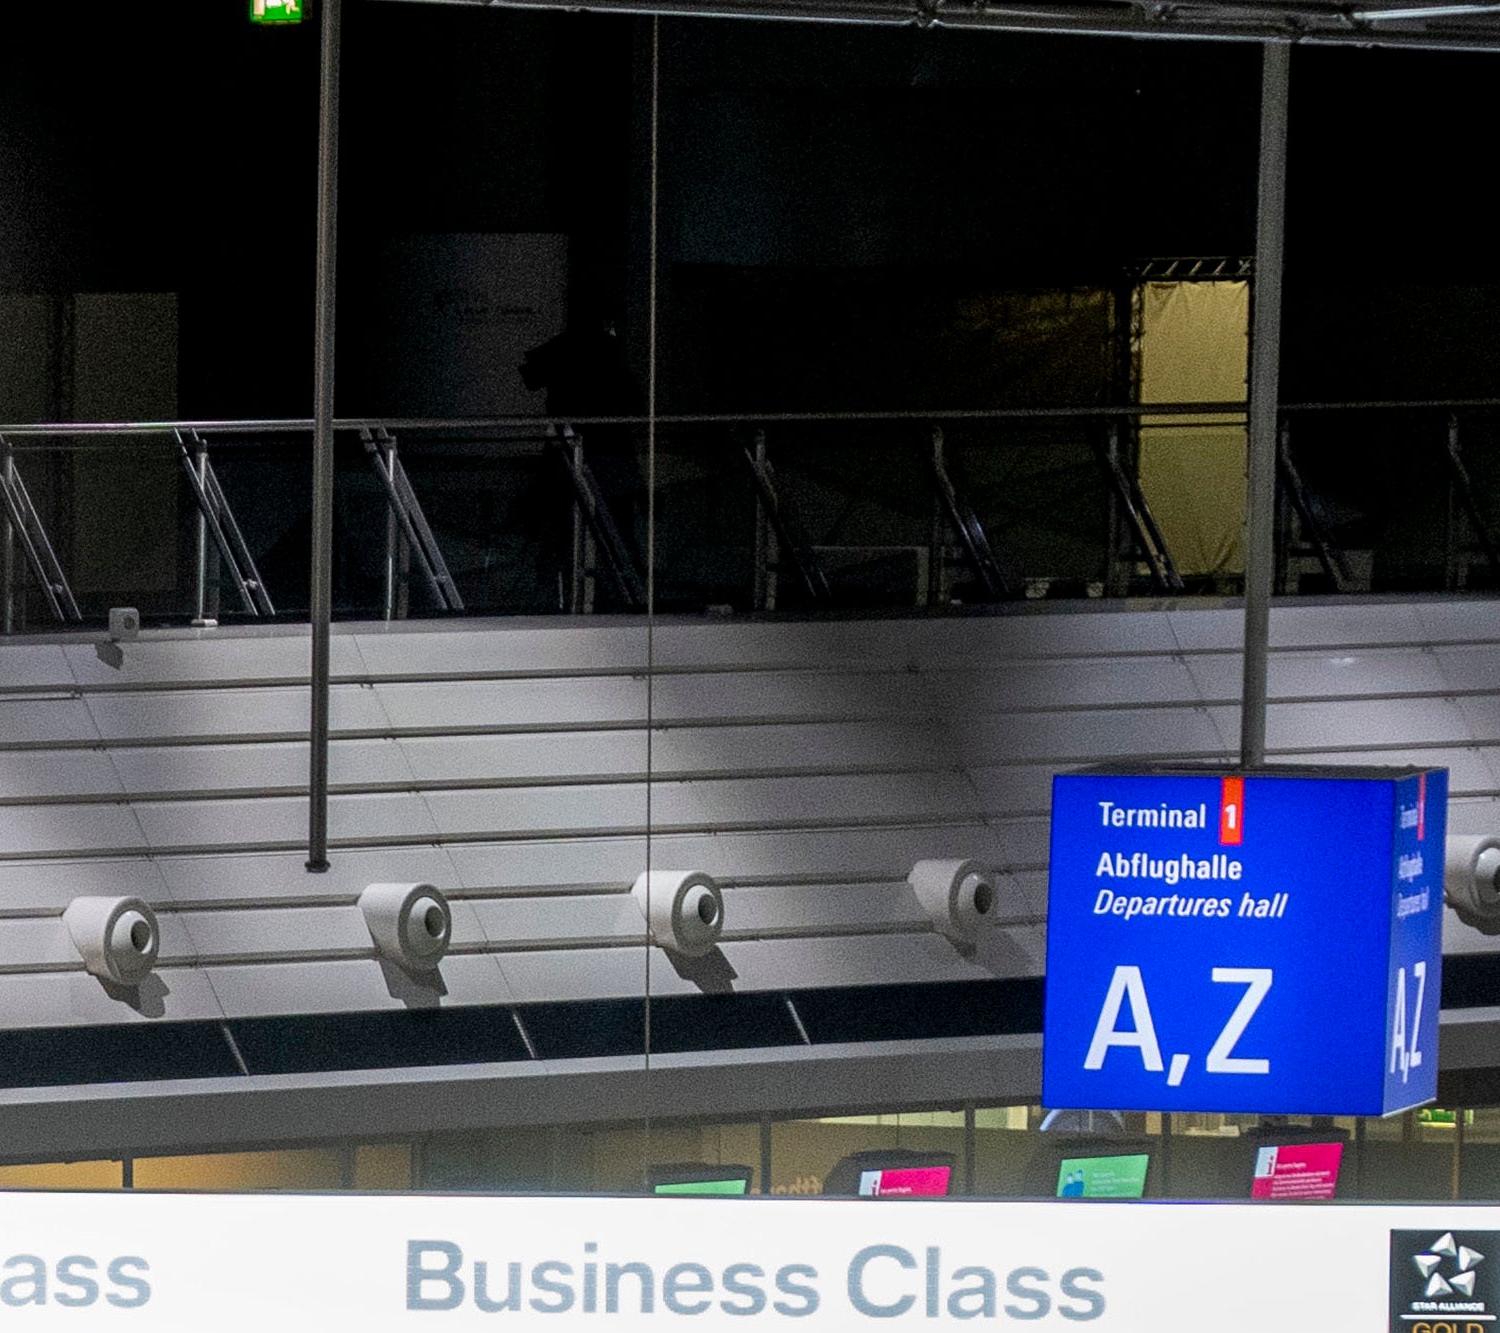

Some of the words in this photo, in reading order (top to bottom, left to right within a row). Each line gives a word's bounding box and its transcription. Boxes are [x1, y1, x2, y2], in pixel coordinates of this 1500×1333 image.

[1098, 800, 1207, 829] Terminal
[1222, 803, 1239, 830] 1
[1095, 851, 1243, 884] Abflughalle
[1092, 888, 1233, 920] Departures
[1236, 890, 1289, 918] hall
[1082, 964, 1274, 1087] A,Z
[404, 1239, 822, 1317] Business
[846, 1243, 1108, 1322] Class
